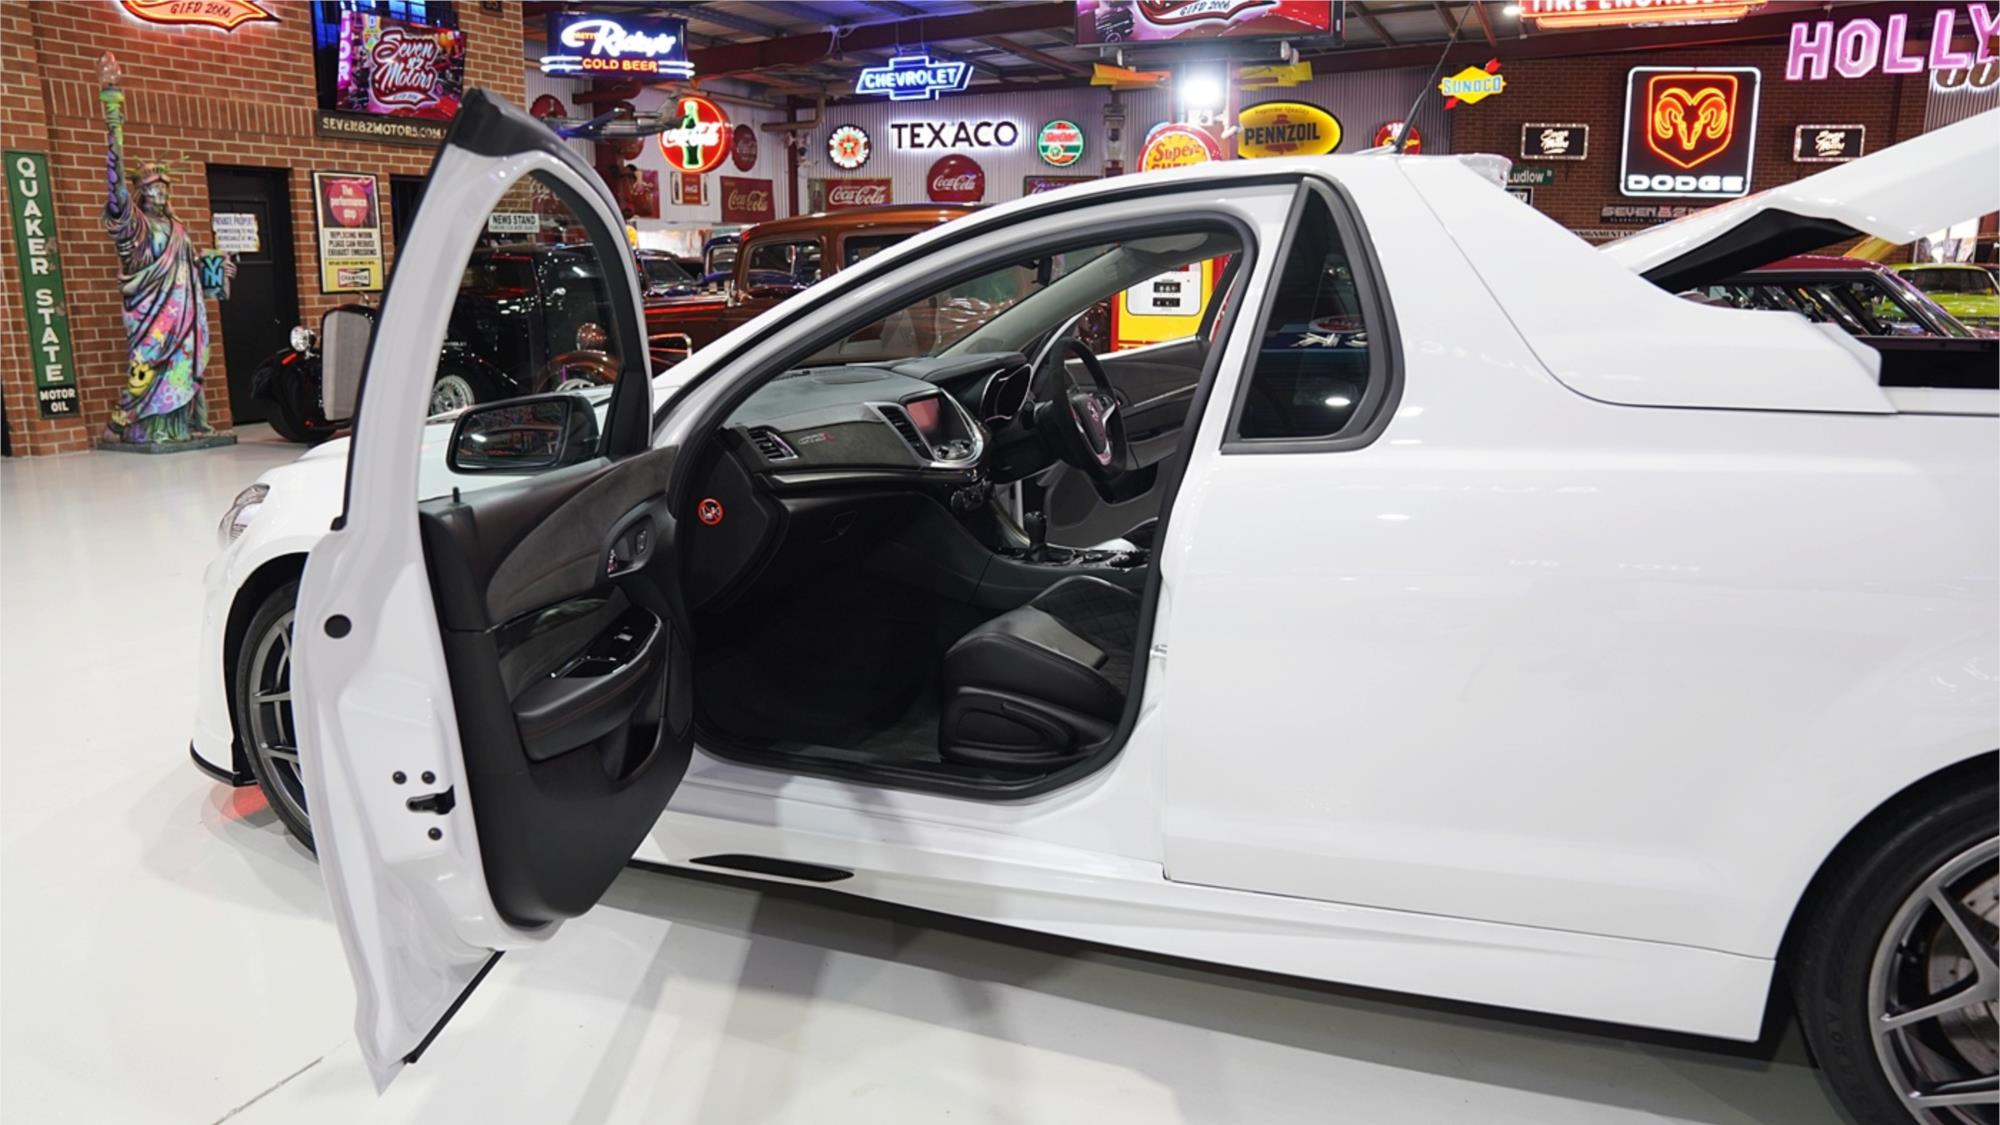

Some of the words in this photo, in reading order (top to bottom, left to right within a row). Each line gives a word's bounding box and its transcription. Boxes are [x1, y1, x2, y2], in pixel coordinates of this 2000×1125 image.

[374, 33, 434, 63] Seven
[582, 58, 620, 70] COLD
[622, 59, 658, 73] BEER
[375, 61, 434, 91] Motors
[864, 67, 957, 89] CHEVROLET
[1443, 76, 1502, 94] SUNOCO
[890, 120, 1019, 149] TEXACO
[1244, 121, 1321, 147] PENNZOIL
[1152, 142, 1202, 162] Super
[1627, 174, 1744, 192] DODGE
[492, 215, 512, 225] NEWS
[513, 214, 537, 225] STAND
[16, 156, 49, 275] QUAKER
[35, 288, 64, 382] STATE
[40, 388, 76, 401] MOTOR
[50, 401, 70, 413] OIL
